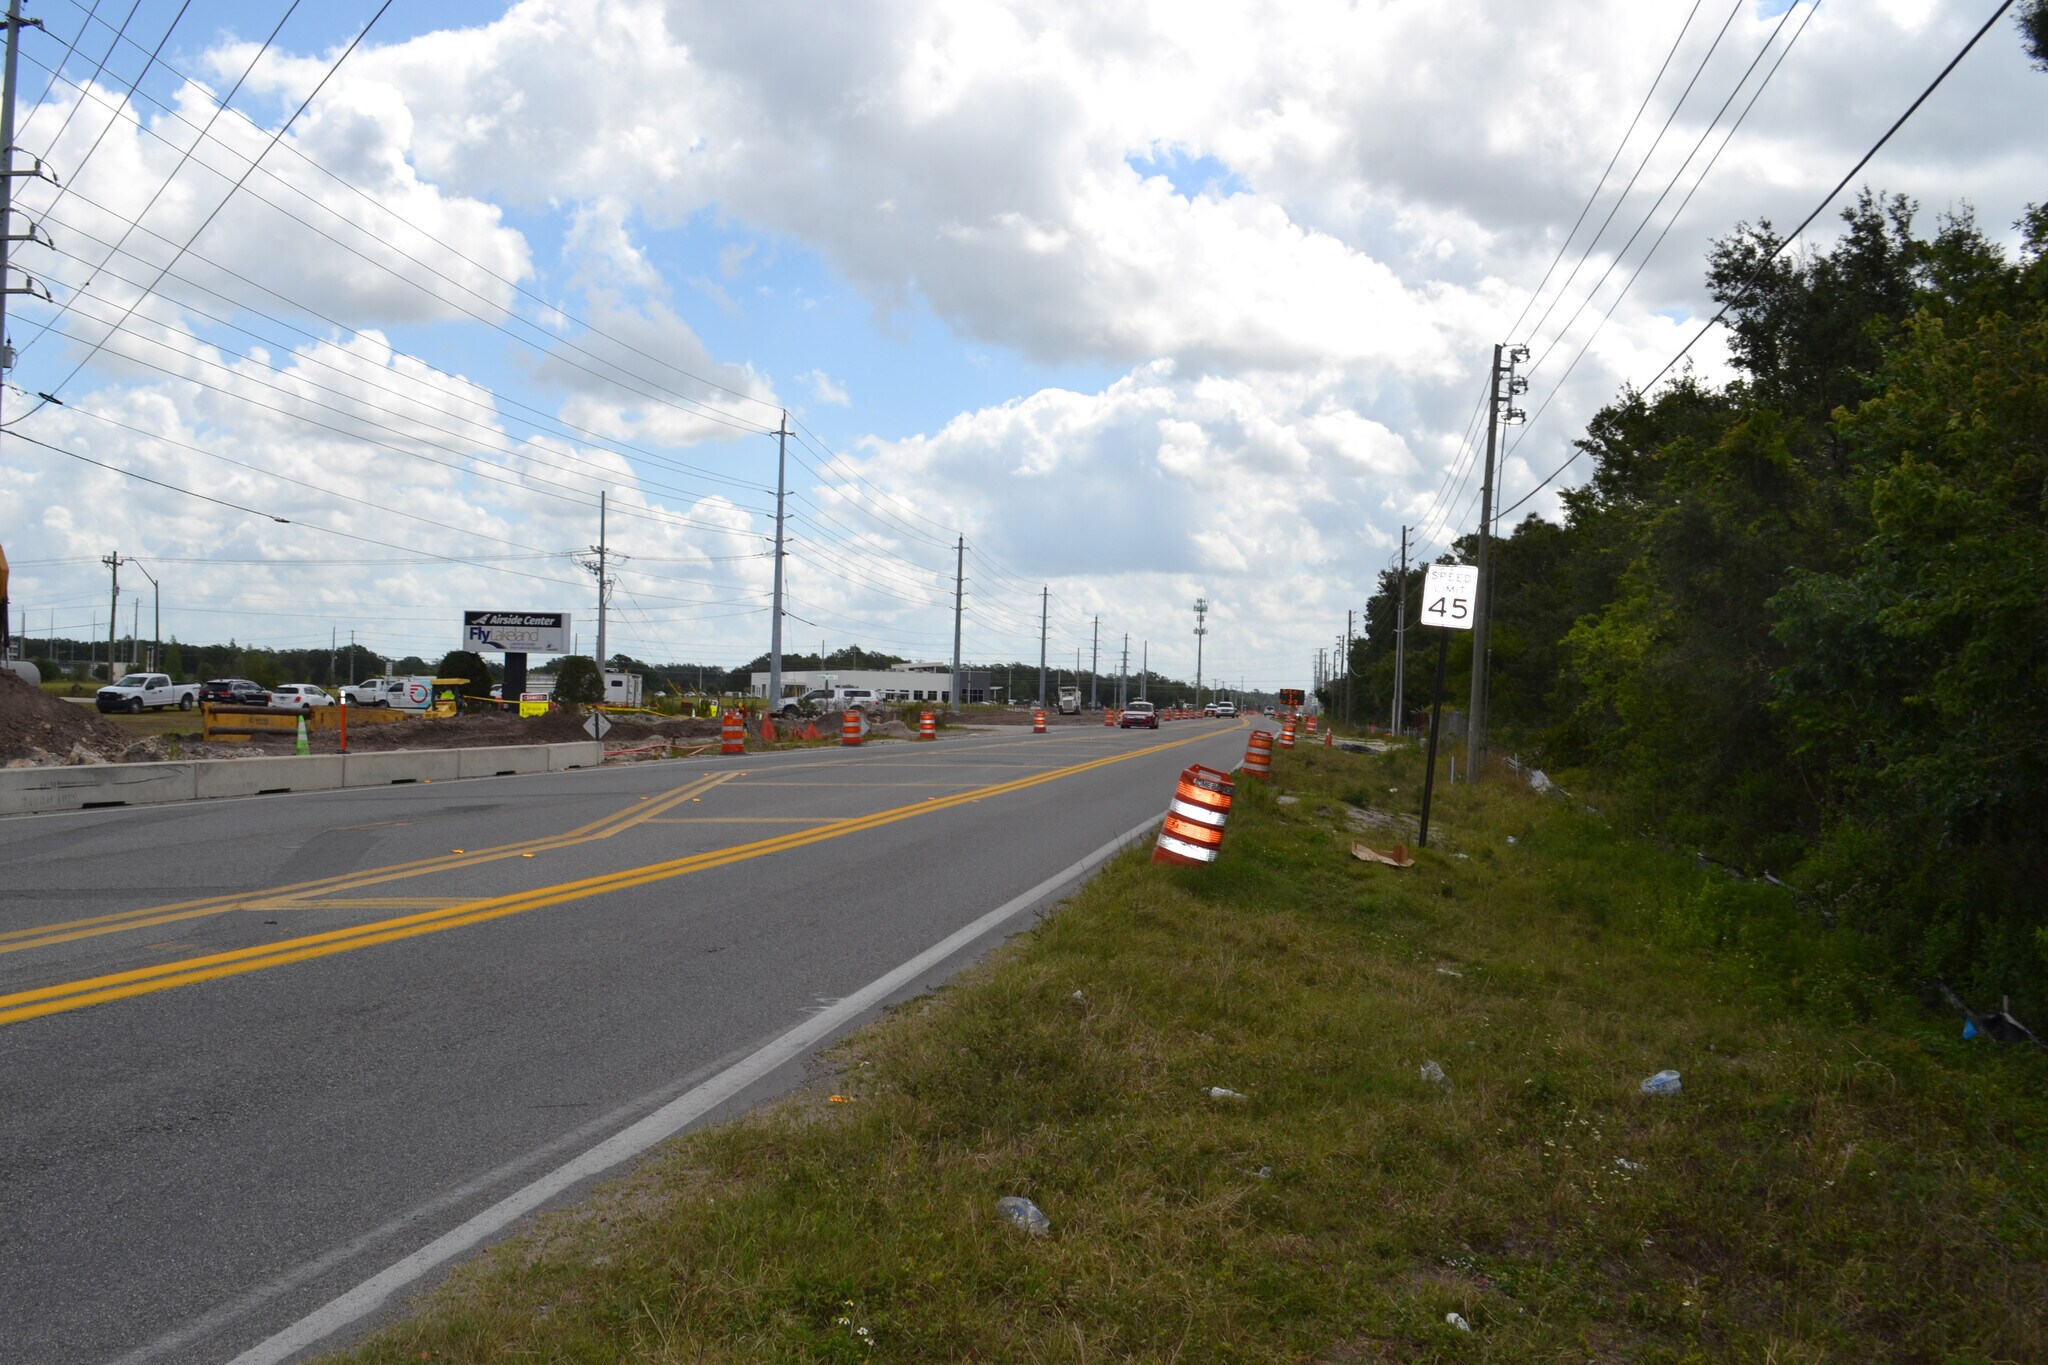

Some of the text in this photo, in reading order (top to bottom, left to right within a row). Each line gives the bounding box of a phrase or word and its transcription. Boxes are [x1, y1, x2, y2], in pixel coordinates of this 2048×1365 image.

[1432, 571, 1471, 583] SPEED
[1435, 586, 1465, 594] LIMIT
[1428, 597, 1467, 619] 45
[490, 614, 555, 626] Airside Center
